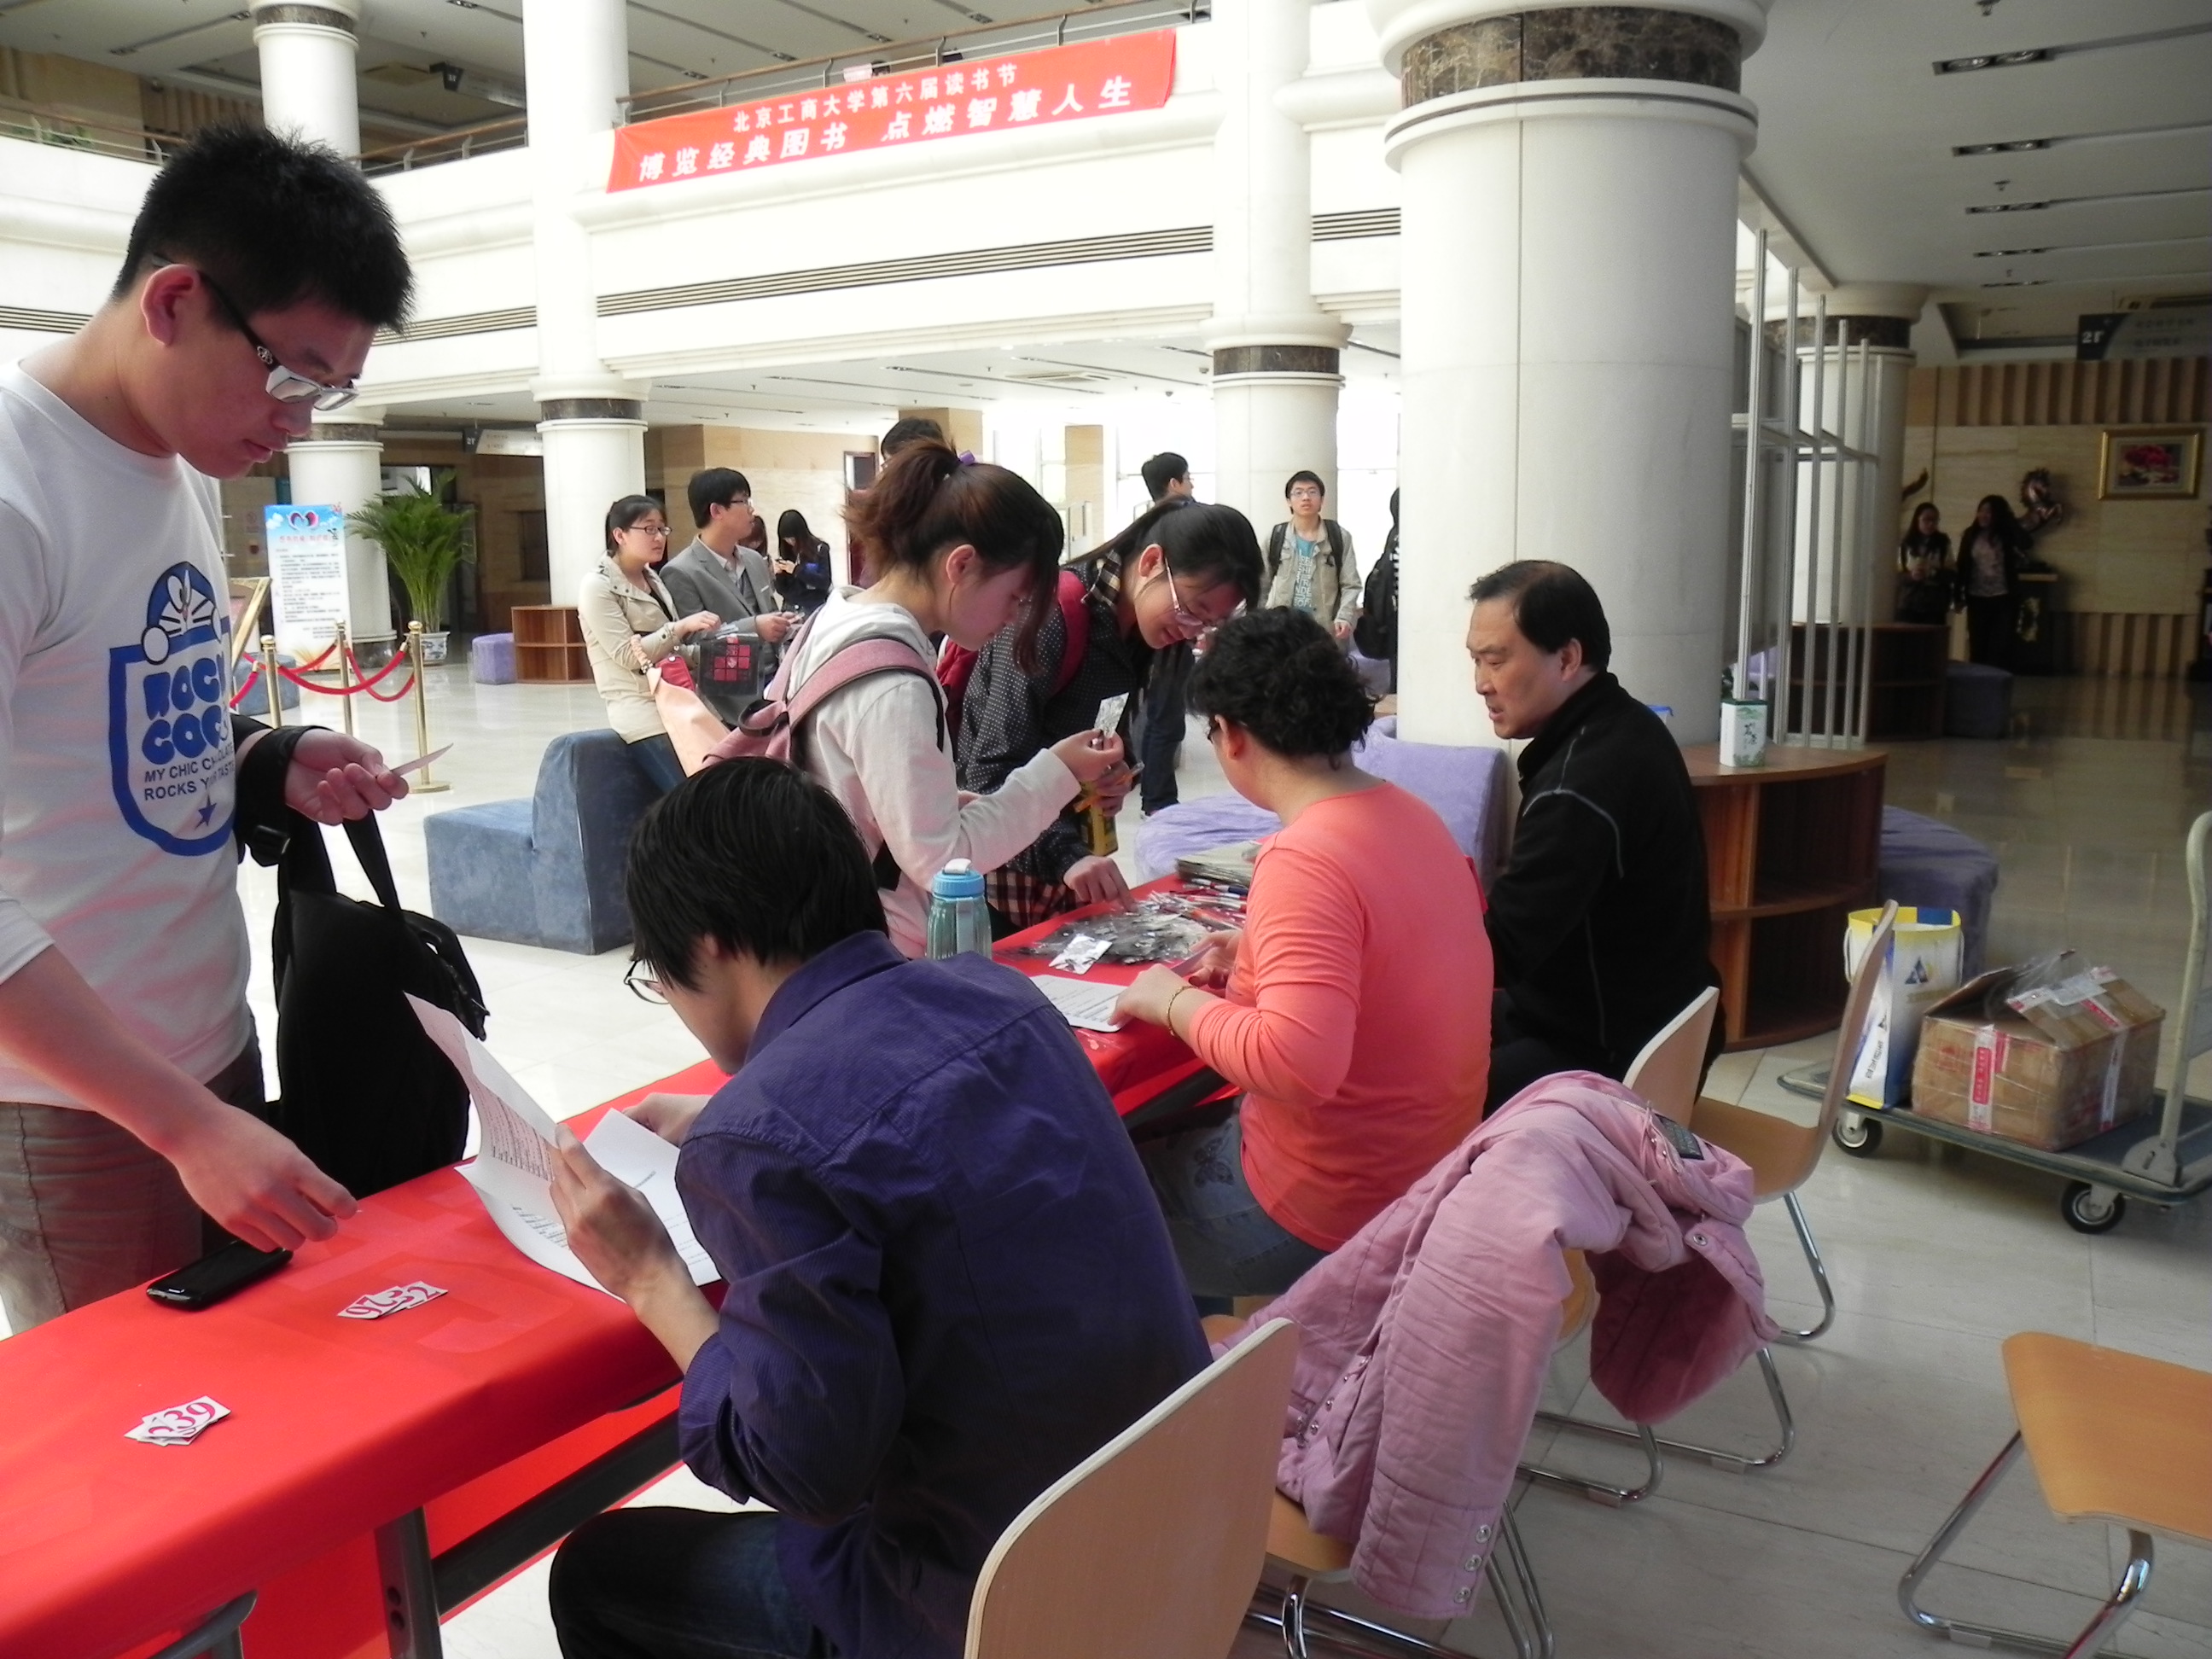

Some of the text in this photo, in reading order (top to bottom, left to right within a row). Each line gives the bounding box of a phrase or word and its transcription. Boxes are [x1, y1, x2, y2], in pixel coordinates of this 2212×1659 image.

[733, 62, 1017, 133] 北京工商大学第六届读书节
[638, 75, 1132, 182] 博览经典图书 点燃智慧人生
[144, 767, 166, 783] MY
[169, 761, 199, 778] CHIC
[144, 781, 197, 800] ROCKS
